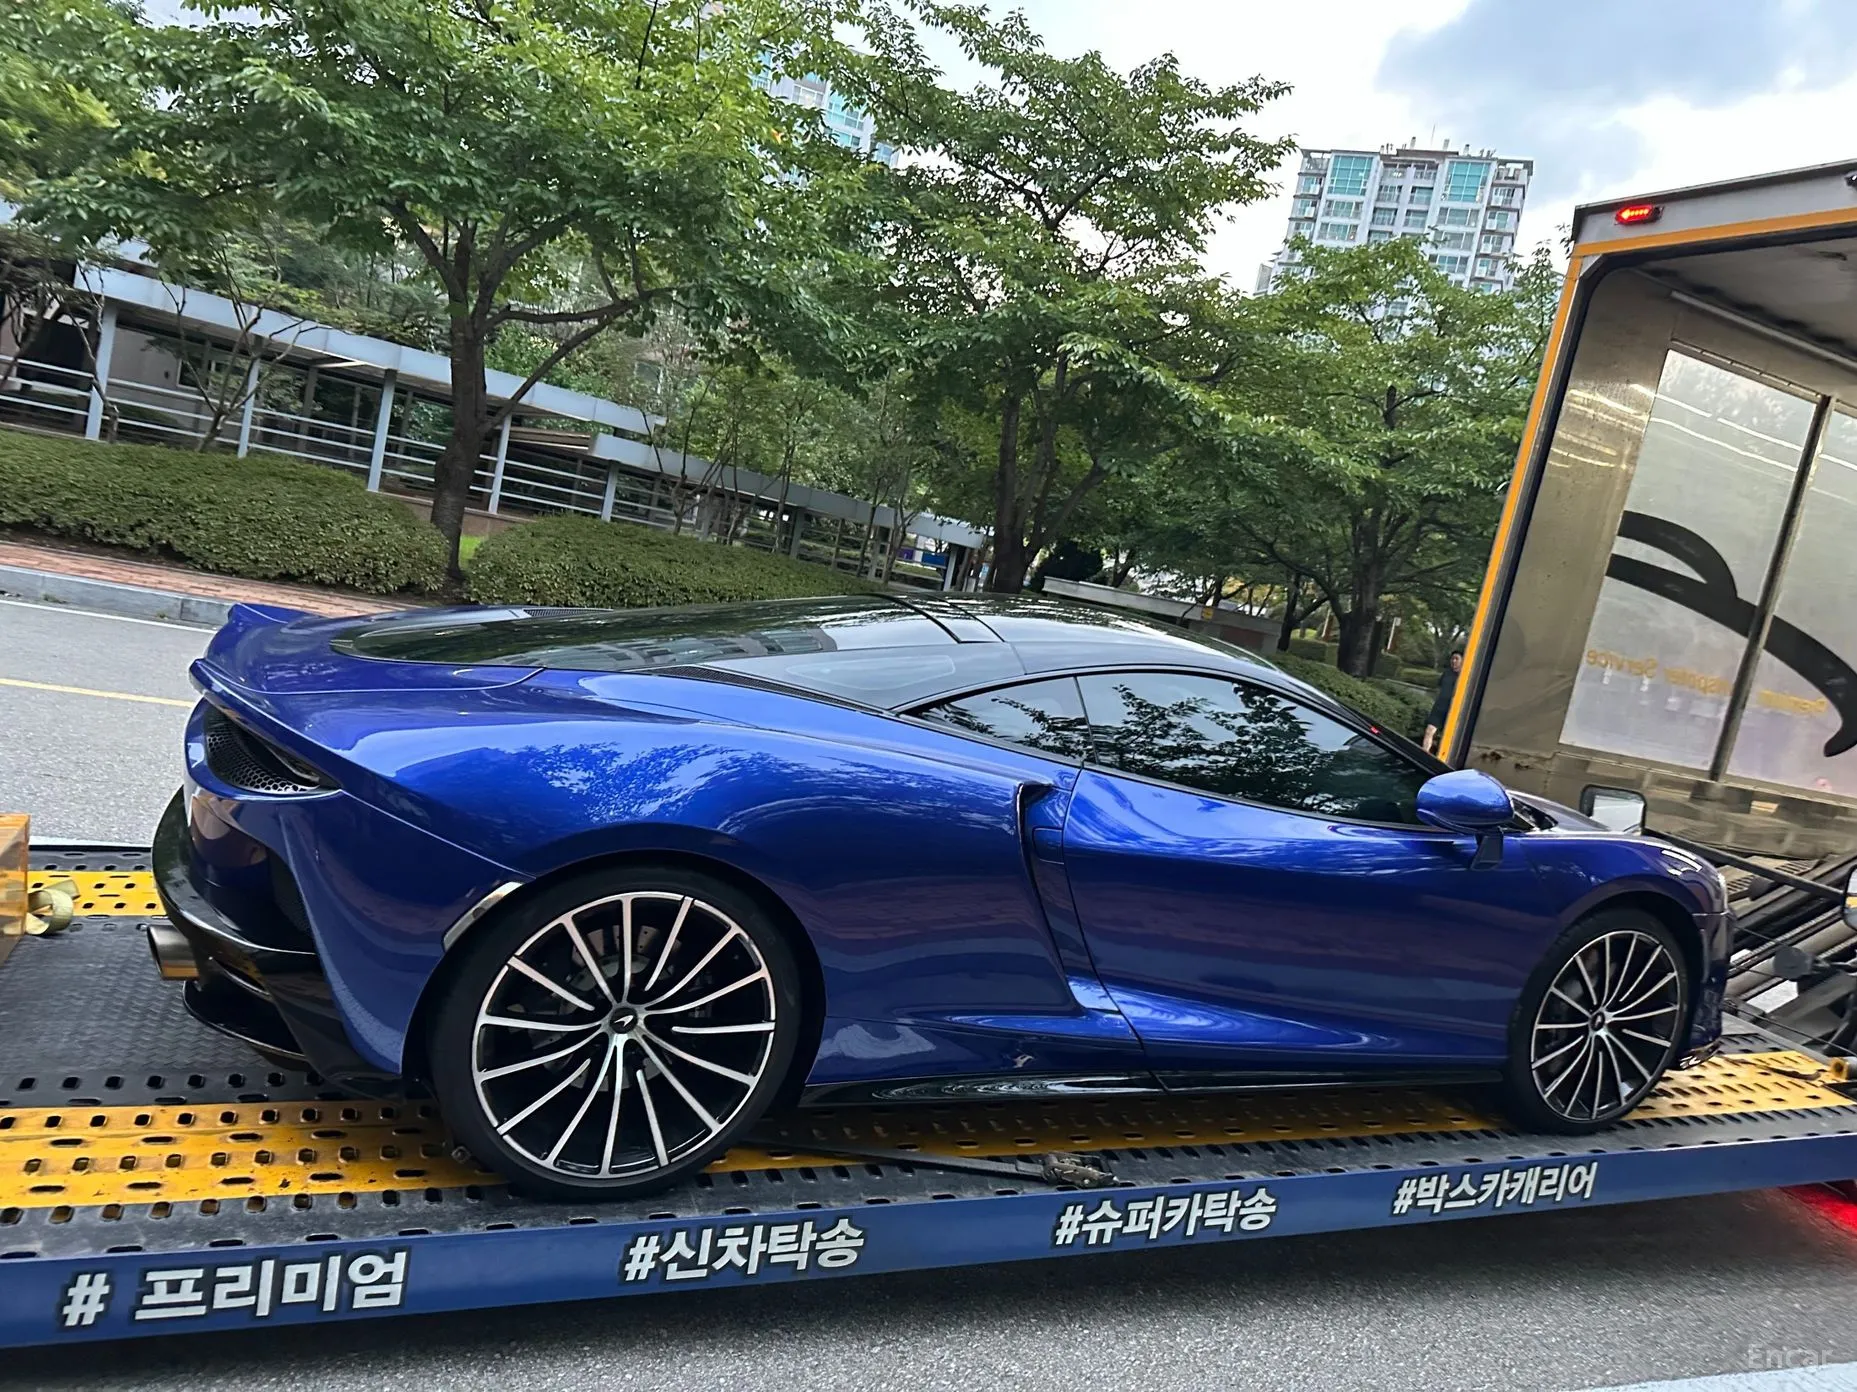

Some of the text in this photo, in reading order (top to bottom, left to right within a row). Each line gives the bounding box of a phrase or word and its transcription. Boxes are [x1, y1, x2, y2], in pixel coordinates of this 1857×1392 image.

[1055, 1187, 1277, 1246] #슈퍼카탁송
[1393, 1161, 1599, 1215] #박스카캐리어
[624, 1218, 865, 1282] #신차탁송
[62, 1251, 407, 1327] # 프리미엄
